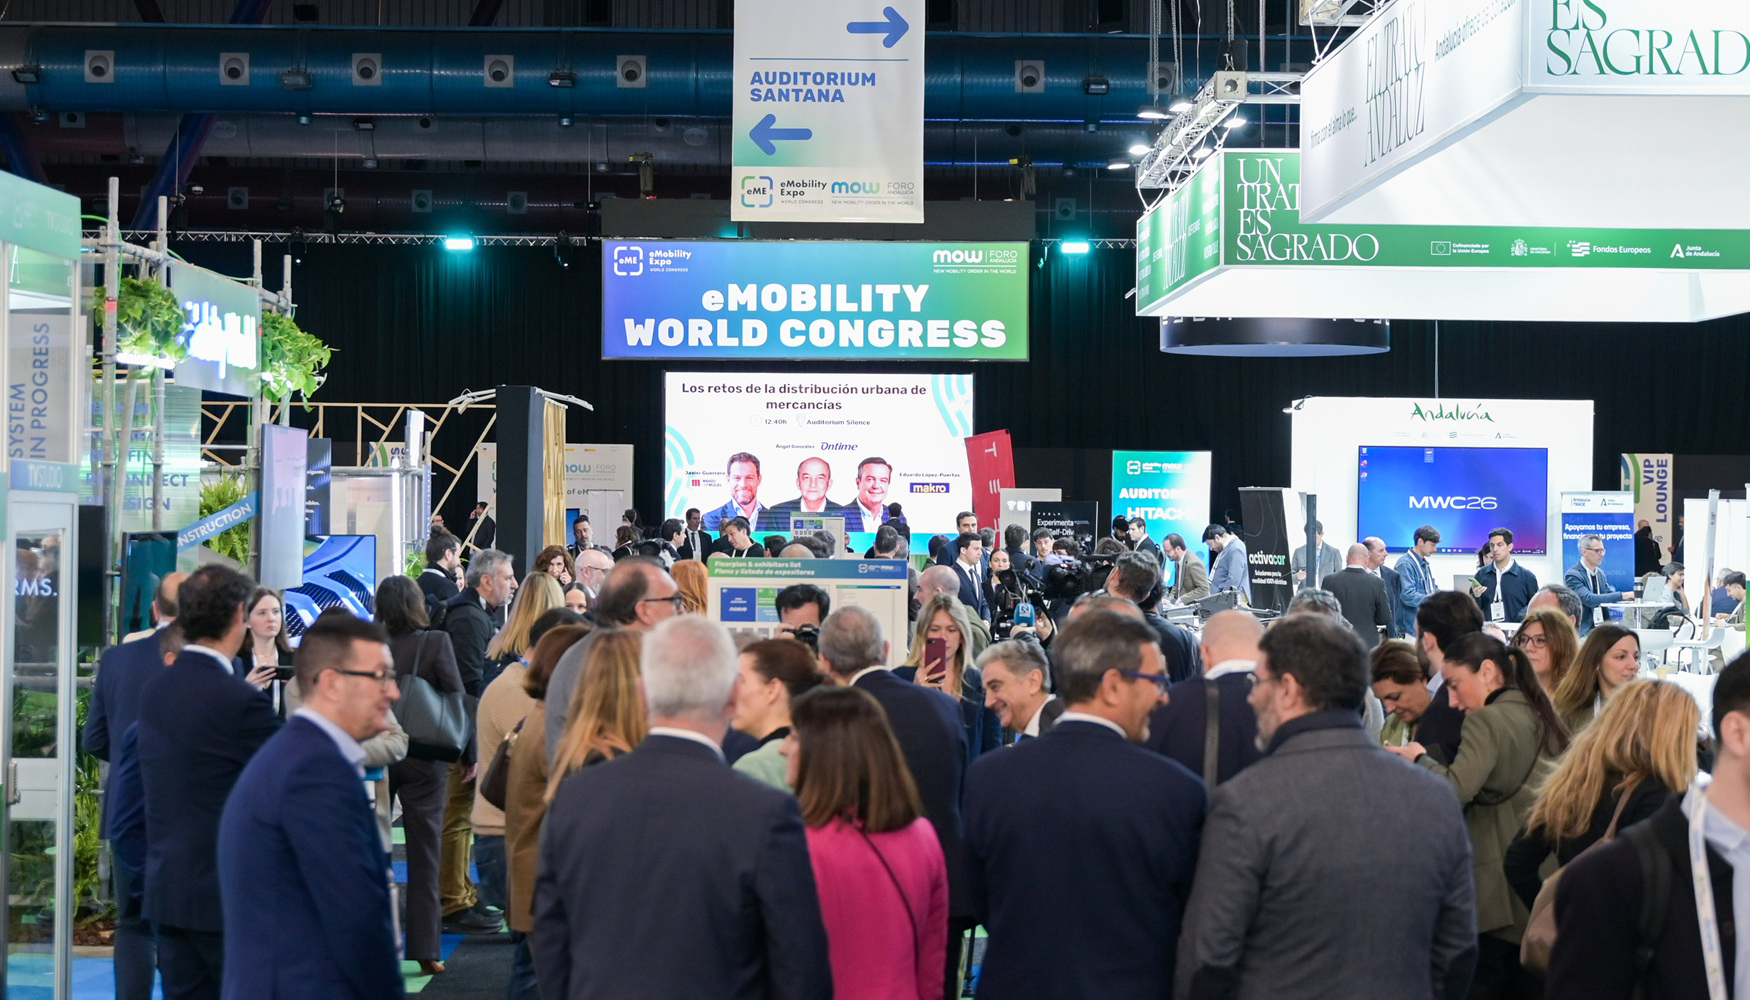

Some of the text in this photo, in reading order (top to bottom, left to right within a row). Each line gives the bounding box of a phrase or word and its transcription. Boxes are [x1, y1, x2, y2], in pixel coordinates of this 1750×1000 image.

[750, 71, 876, 87] AUDITORIUM
[750, 88, 845, 103] SANTANA
[1237, 158, 1284, 185] UN
[746, 187, 767, 196] eME
[780, 180, 827, 190] eMobility
[831, 181, 880, 194] mow
[887, 182, 914, 190] FORO
[780, 189, 805, 198] Expo
[1238, 208, 1272, 236] ES
[1236, 233, 1379, 262] SAGRADO
[1619, 246, 1651, 254] Europeos
[649, 250, 691, 260] eMobility
[933, 250, 982, 263] mow
[649, 258, 672, 266] Expo
[702, 284, 929, 312] eMOBILITY
[624, 318, 1006, 348] WORLD CONGRESS
[30, 323, 50, 458] IN PROGRESS
[682, 383, 927, 395] Los retos de la distribución urbana de
[766, 399, 842, 410] mercancías
[1411, 402, 1495, 422] Andalucía
[9, 383, 26, 458] SYSTEM
[821, 442, 858, 450] Ontime
[566, 464, 591, 473] ow
[1643, 459, 1654, 485] VIP
[913, 482, 946, 493] makro
[1656, 459, 1668, 523] LOUNGE
[1409, 496, 1498, 510] MWC26
[1037, 519, 1074, 527] Experimenta
[1607, 533, 1633, 541] proyecto
